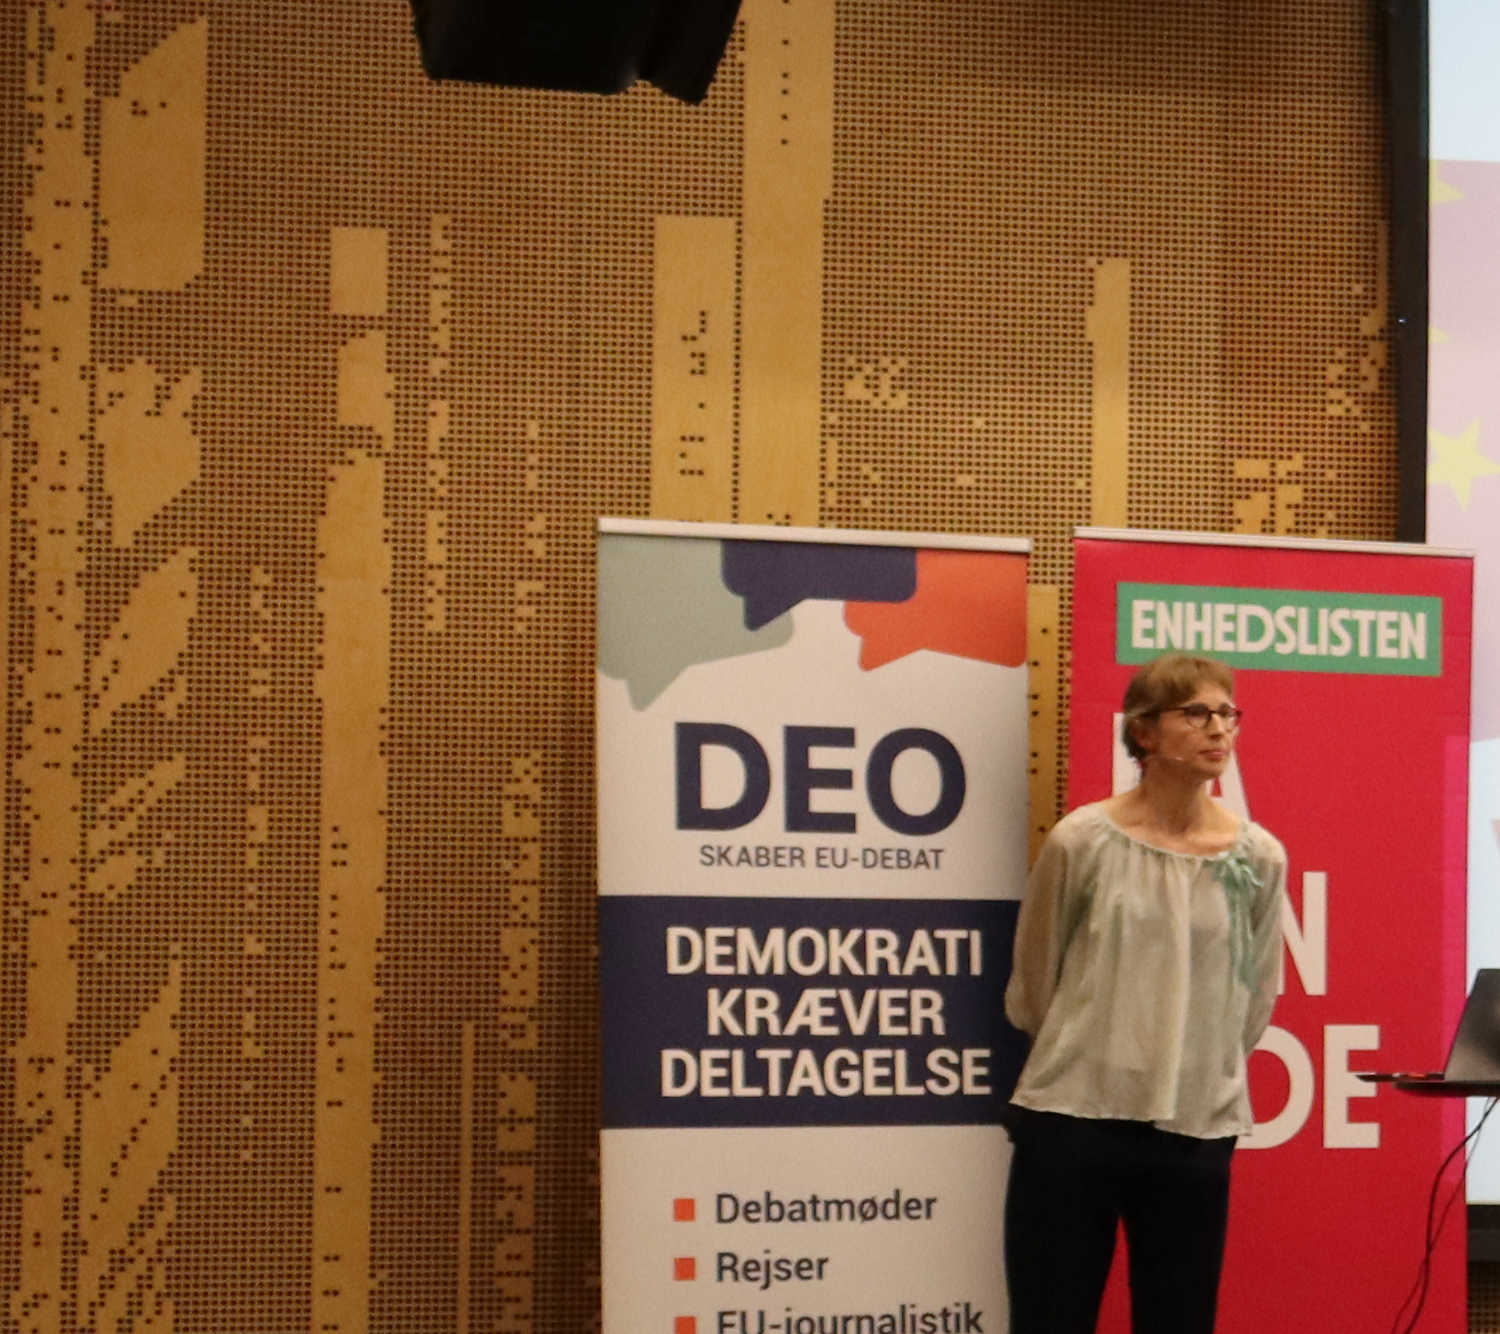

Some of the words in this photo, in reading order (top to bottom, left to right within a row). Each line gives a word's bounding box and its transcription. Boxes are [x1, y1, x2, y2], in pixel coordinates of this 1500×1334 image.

[1131, 598, 1427, 660] ENHEDSLISTEN
[675, 722, 967, 836] DEO
[700, 844, 805, 868] SKABER
[816, 846, 945, 870] EU-DEBAT
[666, 927, 982, 977] DEMOKRATI
[708, 988, 944, 1036] KRÆVER
[662, 1049, 992, 1097] DELTAGELSE
[715, 1189, 938, 1224] Debatmøder
[716, 1250, 830, 1290] Rejser
